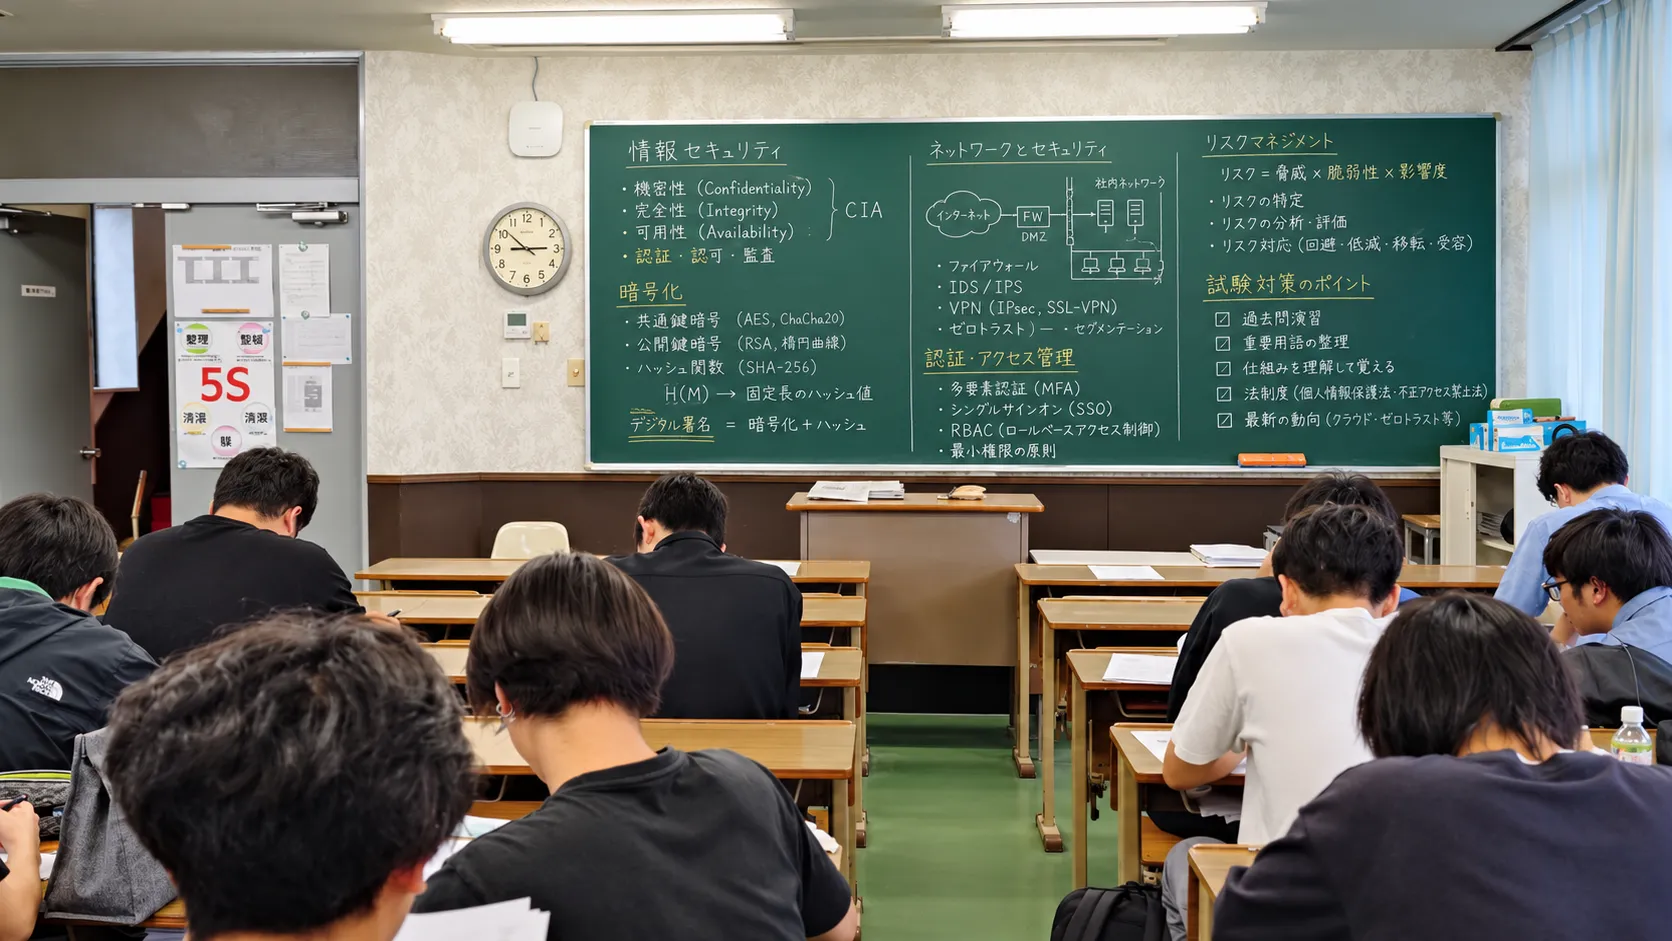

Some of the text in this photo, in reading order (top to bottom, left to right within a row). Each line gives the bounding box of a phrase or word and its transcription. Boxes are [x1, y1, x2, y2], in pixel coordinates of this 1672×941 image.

[1207, 132, 1334, 151] リスクマネジメント
[629, 140, 780, 162] 情報セキュリティ
[930, 141, 1106, 159] ネットワークとセキュリティ
[1222, 168, 1255, 181] リスク
[1327, 164, 1379, 180] 脆弱性
[1399, 163, 1447, 179] 影響度
[634, 177, 811, 199] 機密性 (Confidentiality)
[1095, 176, 1165, 189] 社内ネットワーク
[1223, 192, 1304, 208] リスクの特定
[636, 201, 777, 221] 完全性 (Integrity)
[846, 202, 882, 218] CIA
[937, 209, 990, 220] インターネット
[1024, 211, 1042, 221] FW
[510, 219, 516, 227] 11
[523, 214, 532, 223] 12
[540, 218, 543, 227] 1
[499, 230, 508, 238] 10
[549, 229, 555, 238] 2
[636, 220, 793, 243] 可用性 (Availability)
[495, 244, 500, 253] 9
[554, 244, 559, 253] 3
[1224, 237, 1291, 253] リスク対応
[499, 259, 505, 268] 8
[549, 259, 554, 268] 4
[949, 259, 1038, 272] ファイアウォール
[510, 271, 516, 279] 7
[524, 275, 530, 283] 6
[539, 270, 544, 279] 5
[620, 282, 682, 302] 暗号化
[1206, 273, 1371, 295] 試験対策のポイント
[949, 299, 1117, 316] VPN (IPsec, SSL-VPN)
[637, 310, 844, 329] 共通鍵暗号 (AES, ChaCha20)
[1242, 310, 1320, 327] 過去問演習
[638, 336, 721, 352] 公開鍵暗号
[738, 335, 777, 351] (RSA,
[1243, 334, 1349, 351] 重要用語の整理
[925, 347, 1075, 368] 認証・アクセス管理
[638, 359, 816, 376] ハッシュ関数 (SHA-256)
[1243, 358, 1394, 375] 仕組みを理解して覚える
[201, 366, 250, 402] 5S
[952, 381, 1080, 397] 多要素認証 (MFA)
[666, 385, 873, 403] H(M) 固定長のハッシュ値
[1245, 385, 1288, 401] 法制度
[952, 401, 1112, 417] シングルサインオン (SSO)
[631, 416, 710, 433] デジタル署名
[1245, 411, 1319, 428] 最新の動向
[952, 421, 1160, 438] RBAC (ロールベースアクセス制御)
[951, 443, 1055, 459] 最小権限の原則
